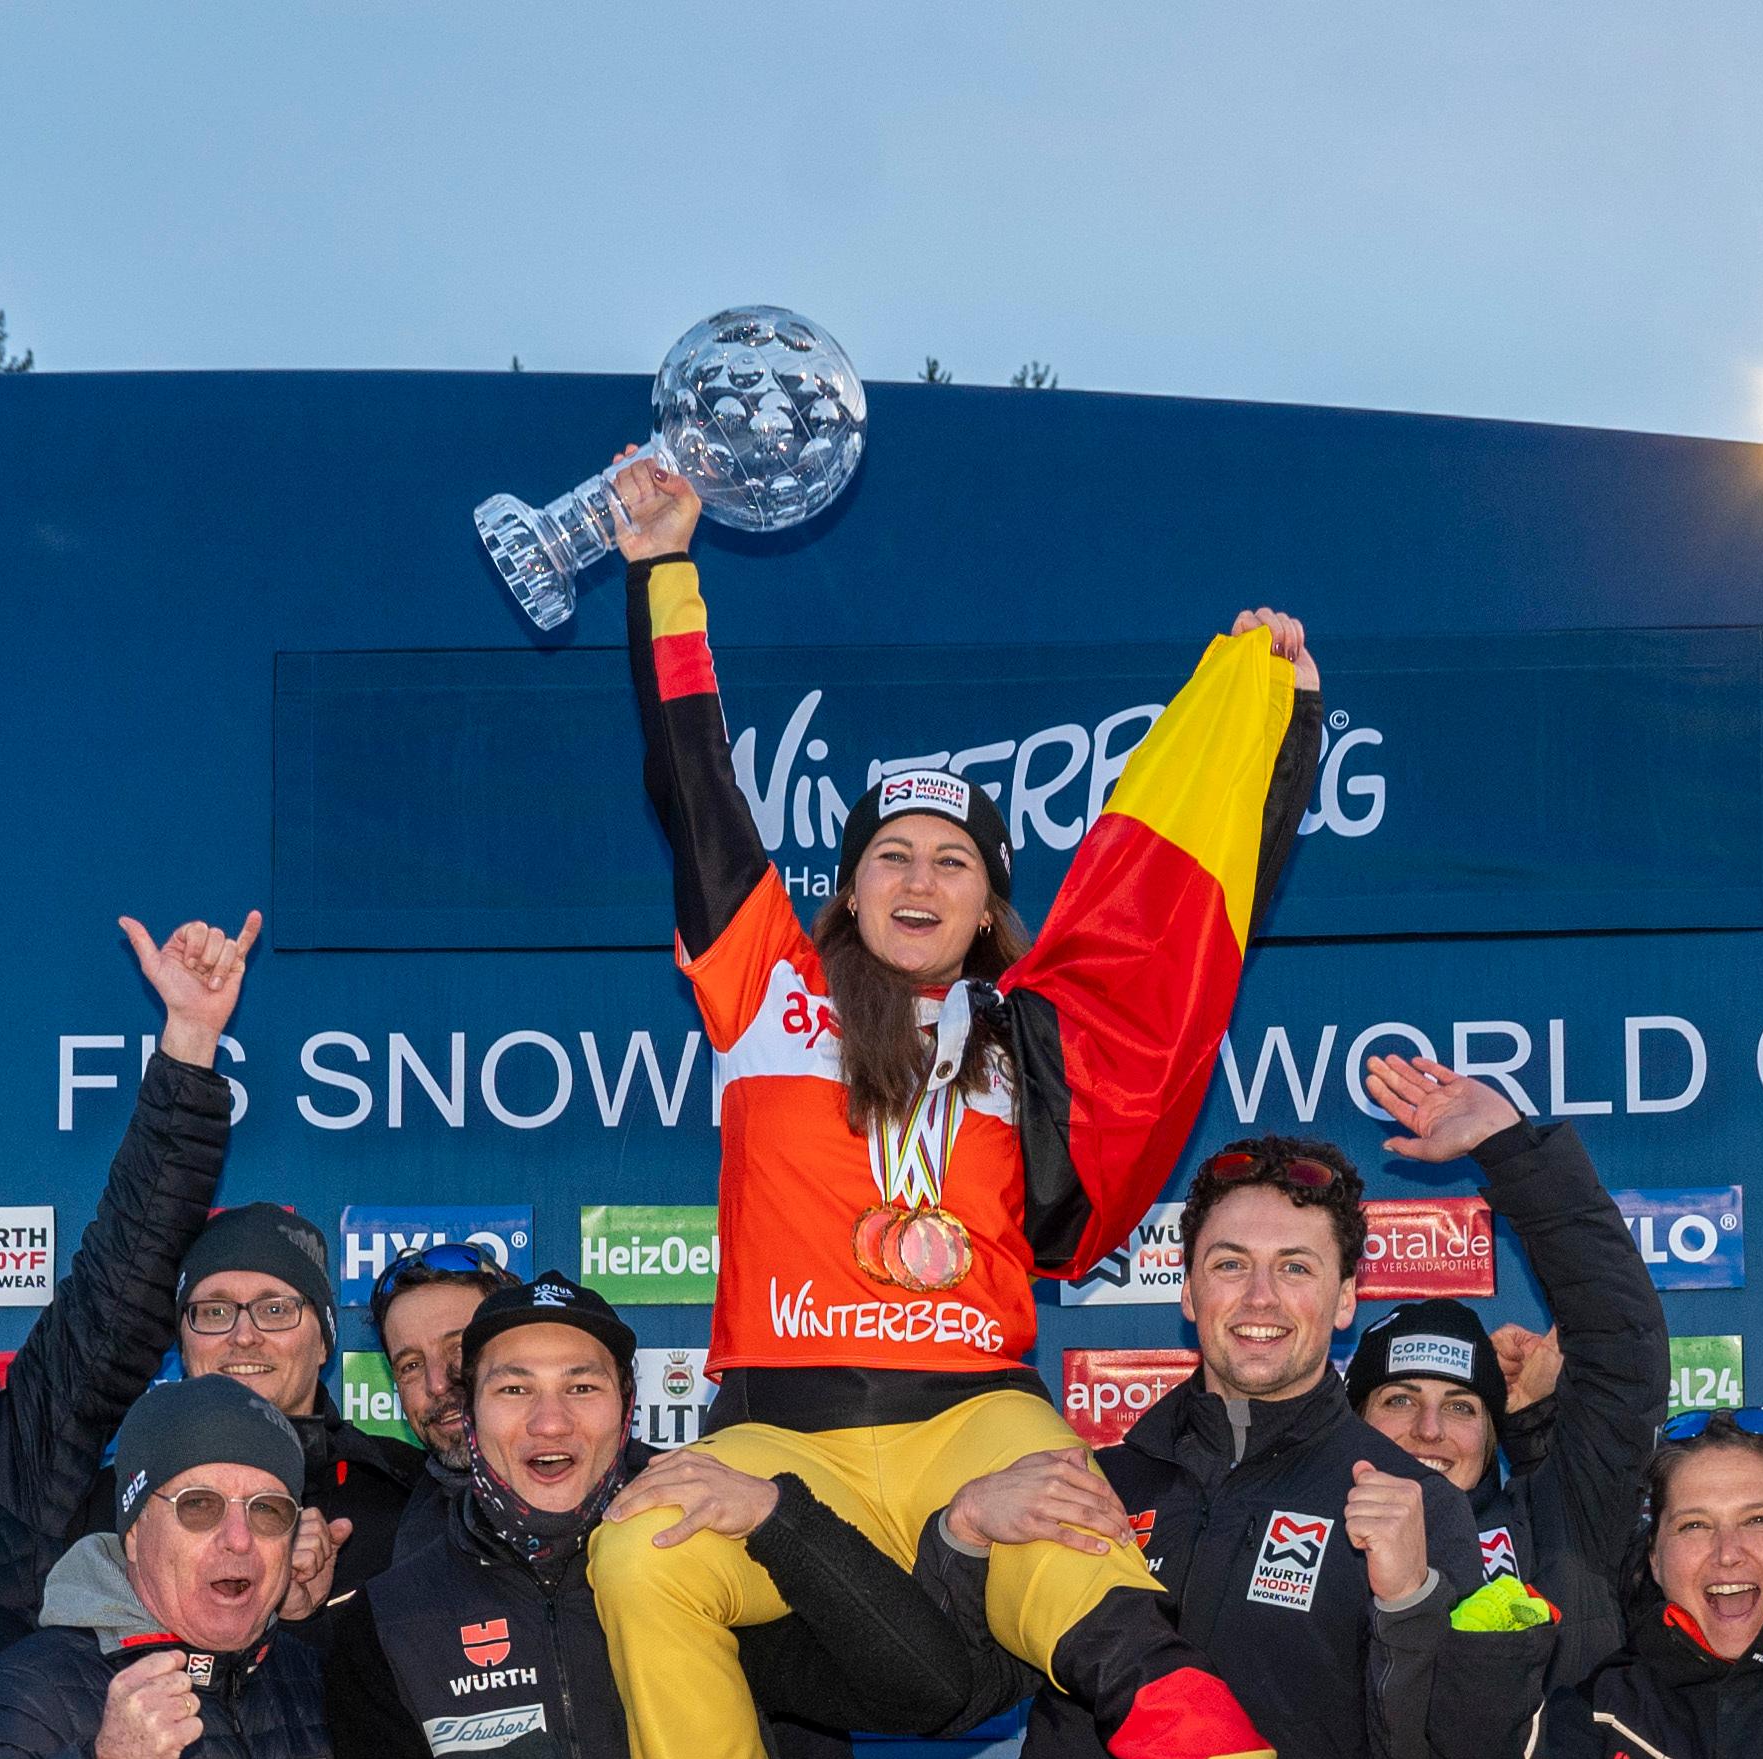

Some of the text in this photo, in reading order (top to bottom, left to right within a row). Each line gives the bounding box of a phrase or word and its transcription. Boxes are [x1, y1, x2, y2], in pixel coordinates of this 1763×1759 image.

[1223, 1014, 1707, 1124] WORLD
[1382, 1259, 1490, 1273] VERSANDAPOTHEKE
[1392, 1341, 1470, 1361] CORPORE
[1392, 1355, 1469, 1369] PHYSIOTHERAPIE
[1255, 1577, 1310, 1595] MODYF
[1253, 1590, 1307, 1606] WORKWEAR
[432, 1706, 542, 1747] Schubert
